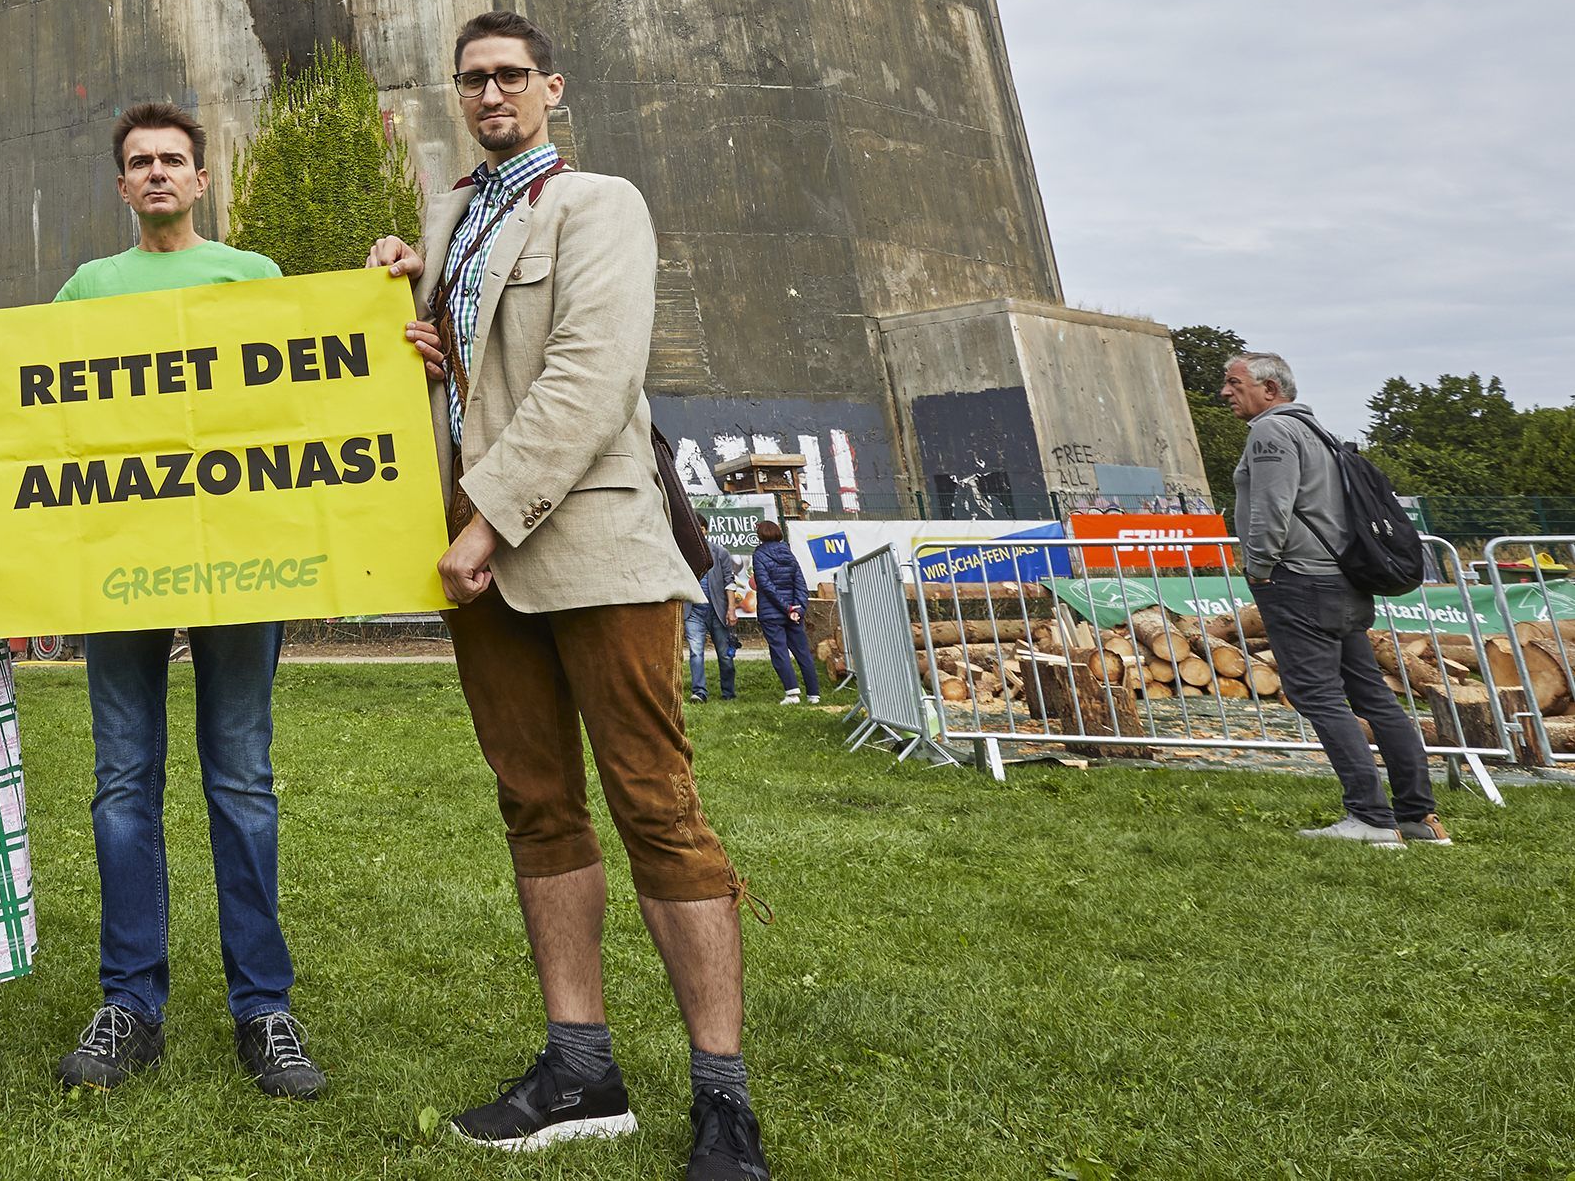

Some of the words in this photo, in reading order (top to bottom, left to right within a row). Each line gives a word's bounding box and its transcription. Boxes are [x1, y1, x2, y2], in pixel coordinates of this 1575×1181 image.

[20, 346, 218, 407] RETTET
[241, 332, 370, 387] DEN
[1051, 444, 1095, 466] FREE
[13, 433, 399, 510] AMAZONAS!
[1060, 469, 1089, 488] ALL
[824, 539, 845, 554] NV
[102, 554, 328, 605] GREENPEACE
[922, 562, 949, 581] WIR
